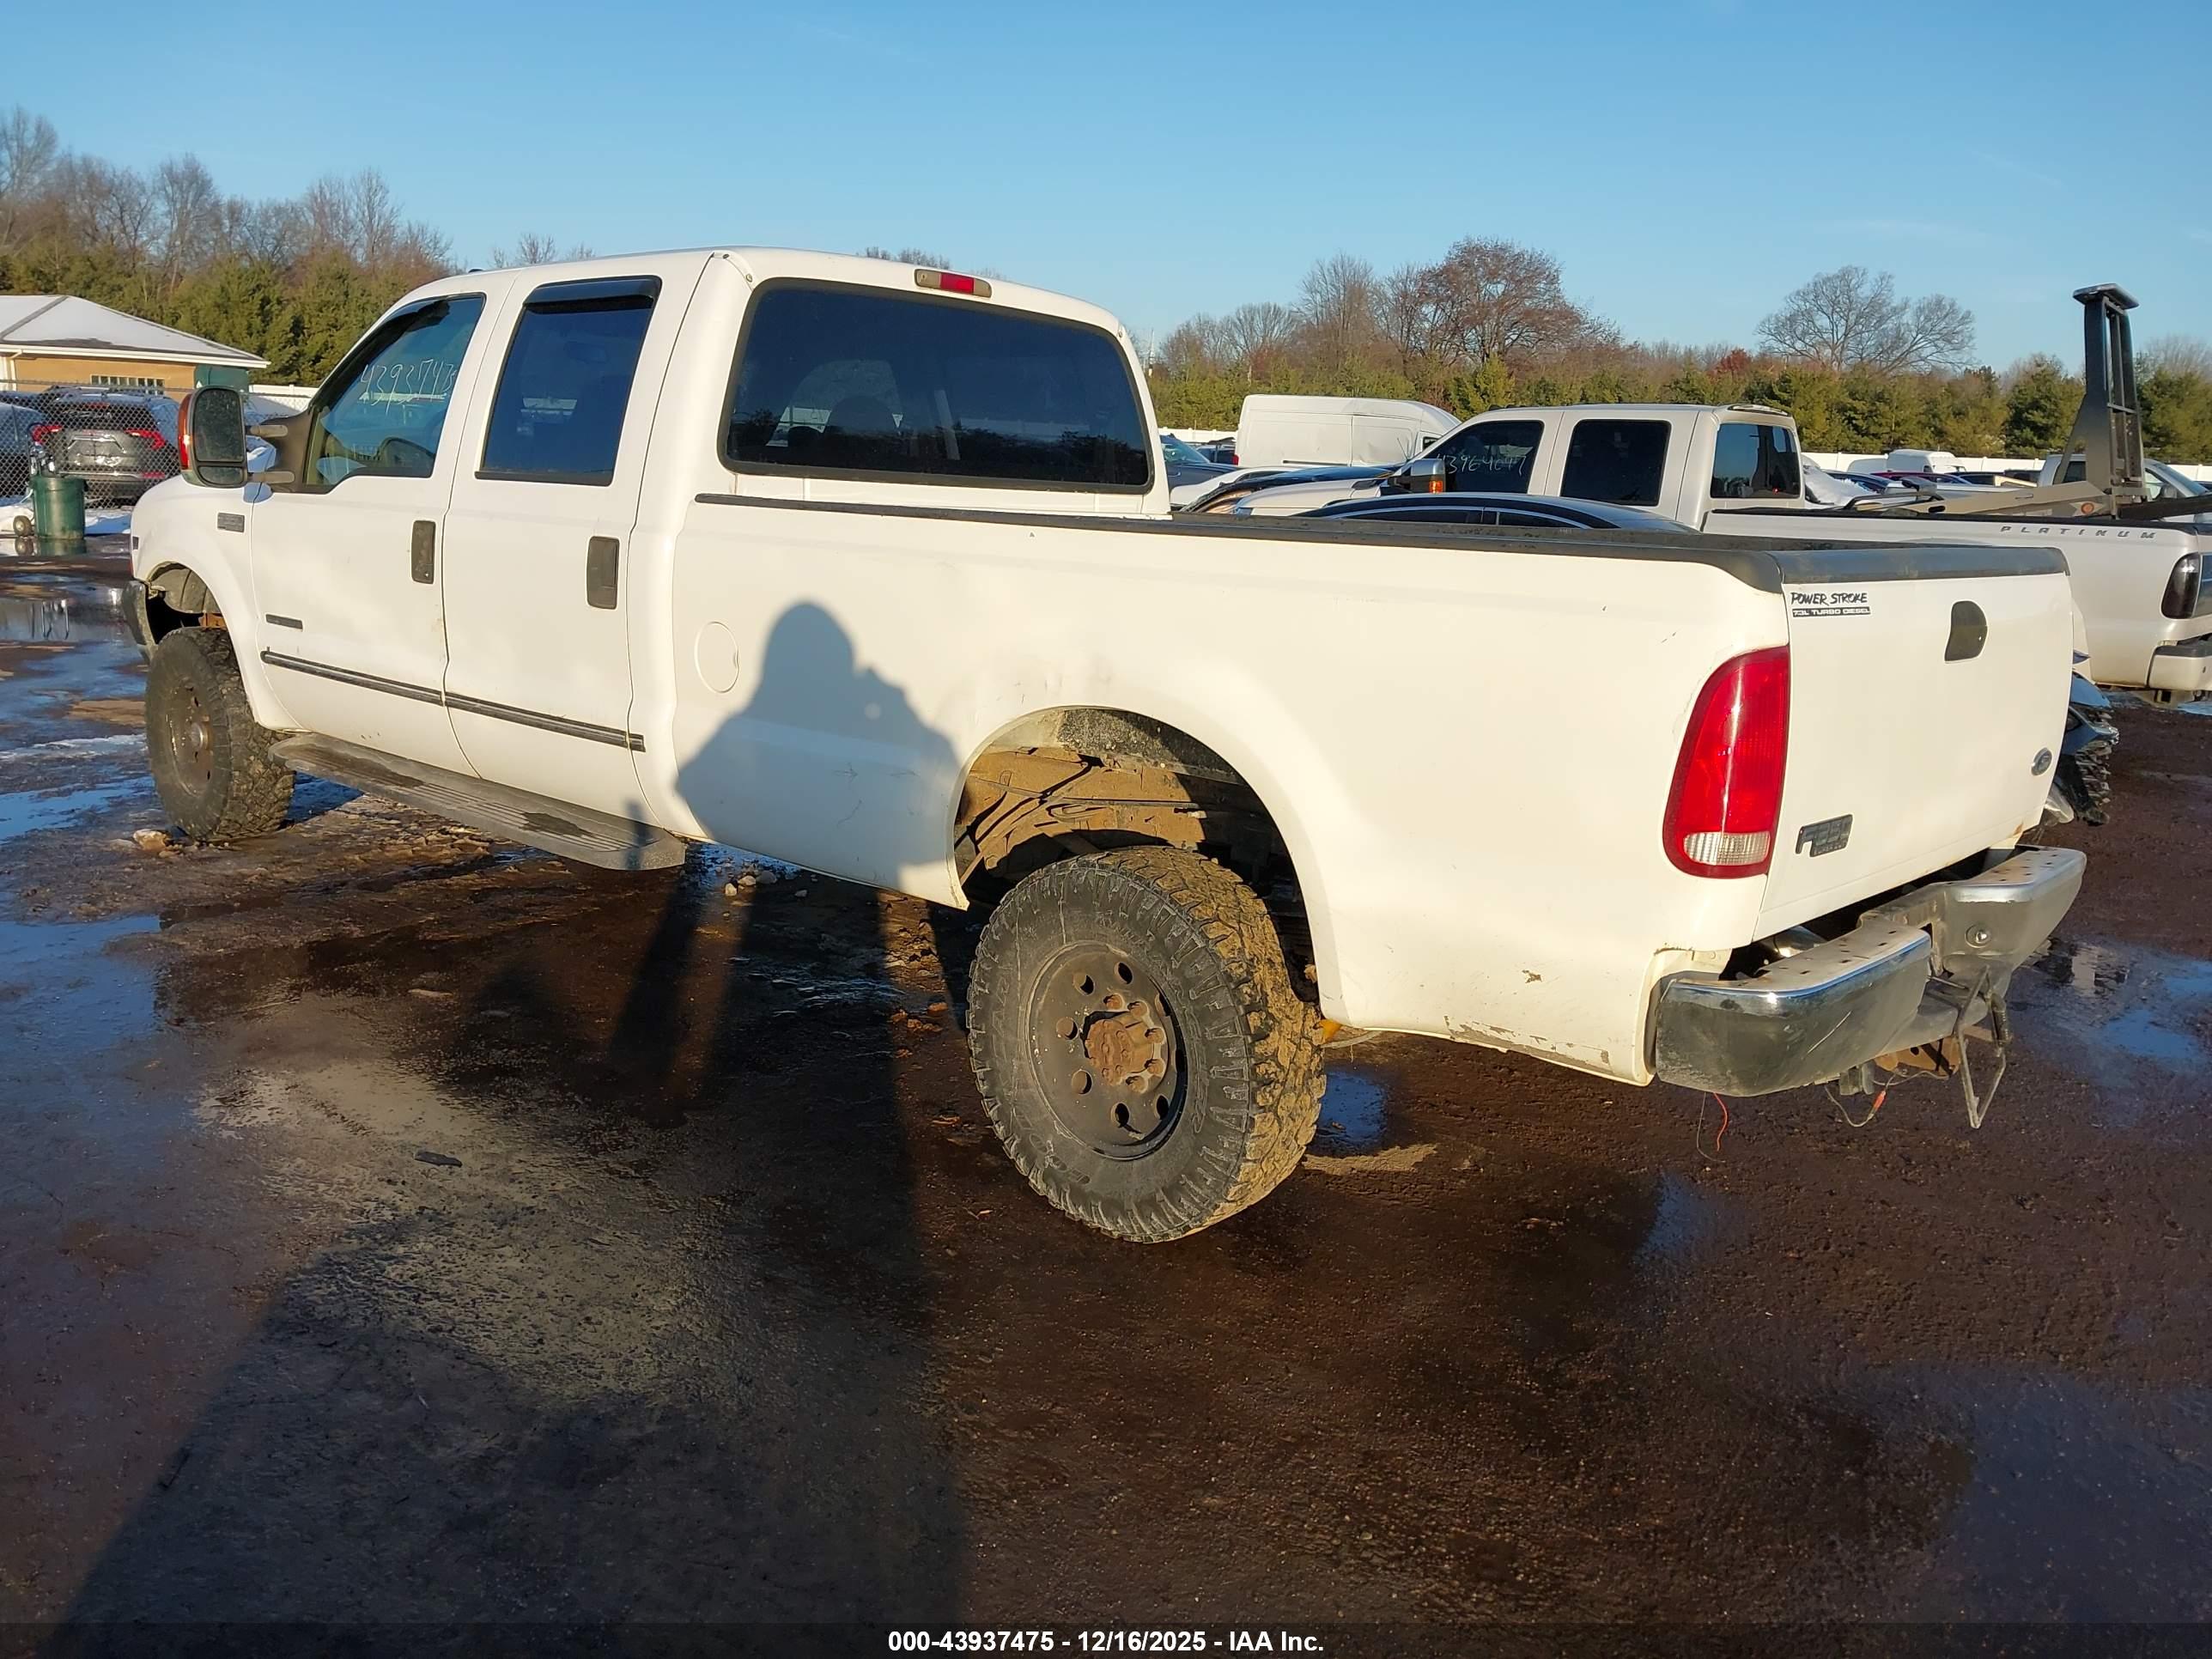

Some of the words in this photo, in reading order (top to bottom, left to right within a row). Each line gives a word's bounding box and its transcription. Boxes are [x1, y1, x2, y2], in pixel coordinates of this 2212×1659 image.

[2000, 526, 2157, 539] PLATINUM
[1790, 592, 1830, 606] POWER
[1830, 592, 1868, 605] STROKE
